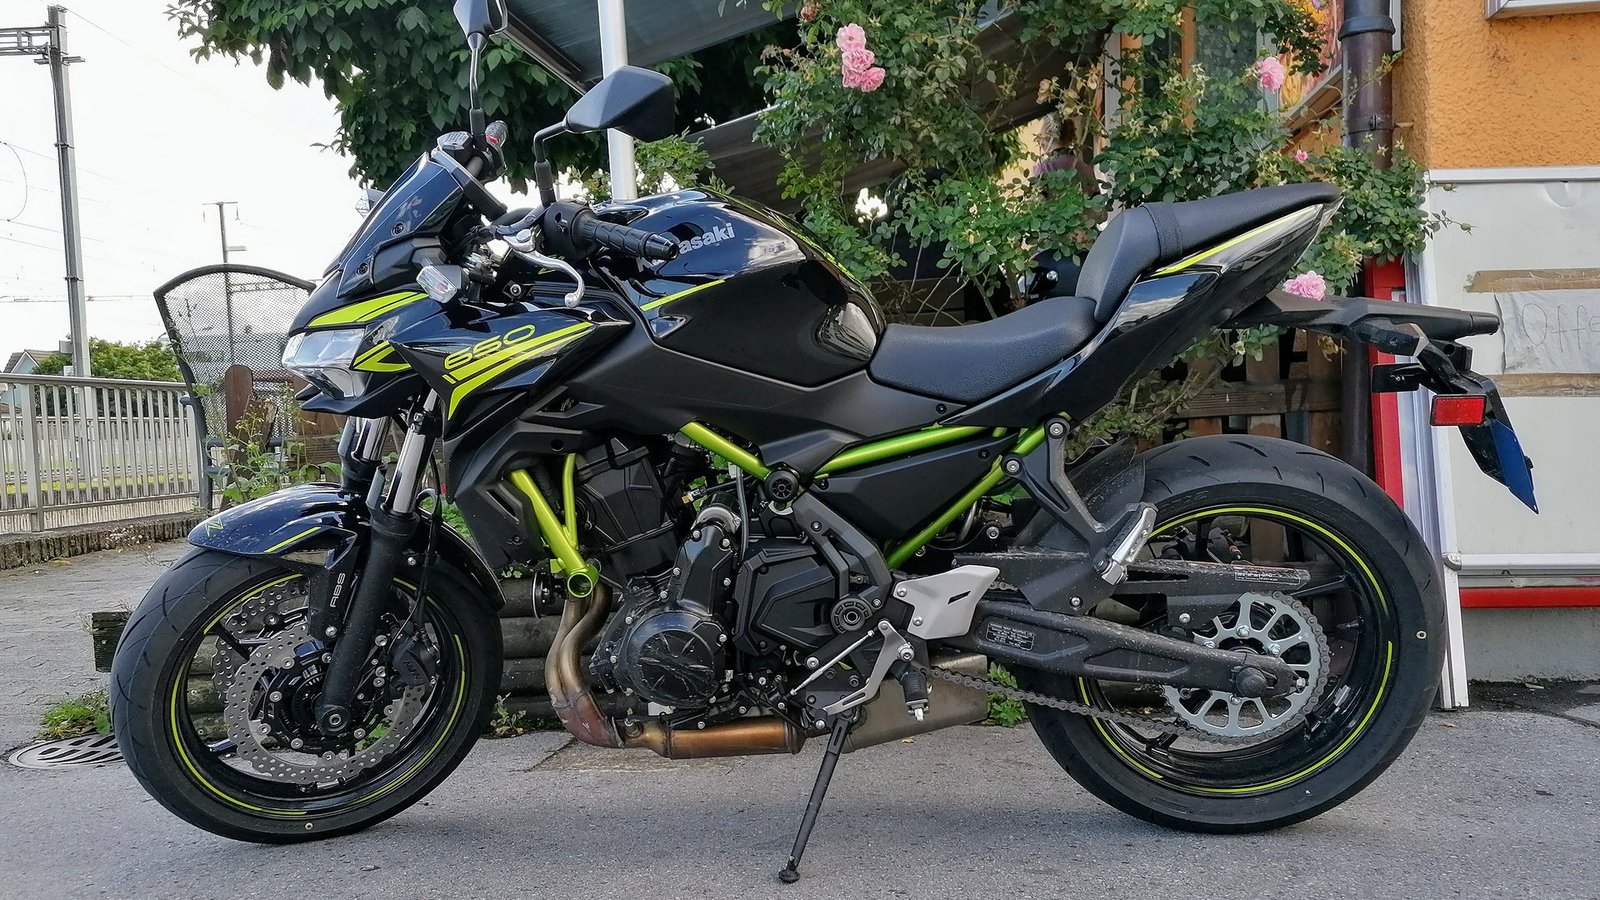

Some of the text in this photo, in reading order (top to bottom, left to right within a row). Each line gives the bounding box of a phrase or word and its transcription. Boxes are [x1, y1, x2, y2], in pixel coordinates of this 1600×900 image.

[636, 222, 736, 273] Kasaki
[444, 324, 536, 370] 650
[329, 572, 346, 608] ABS
